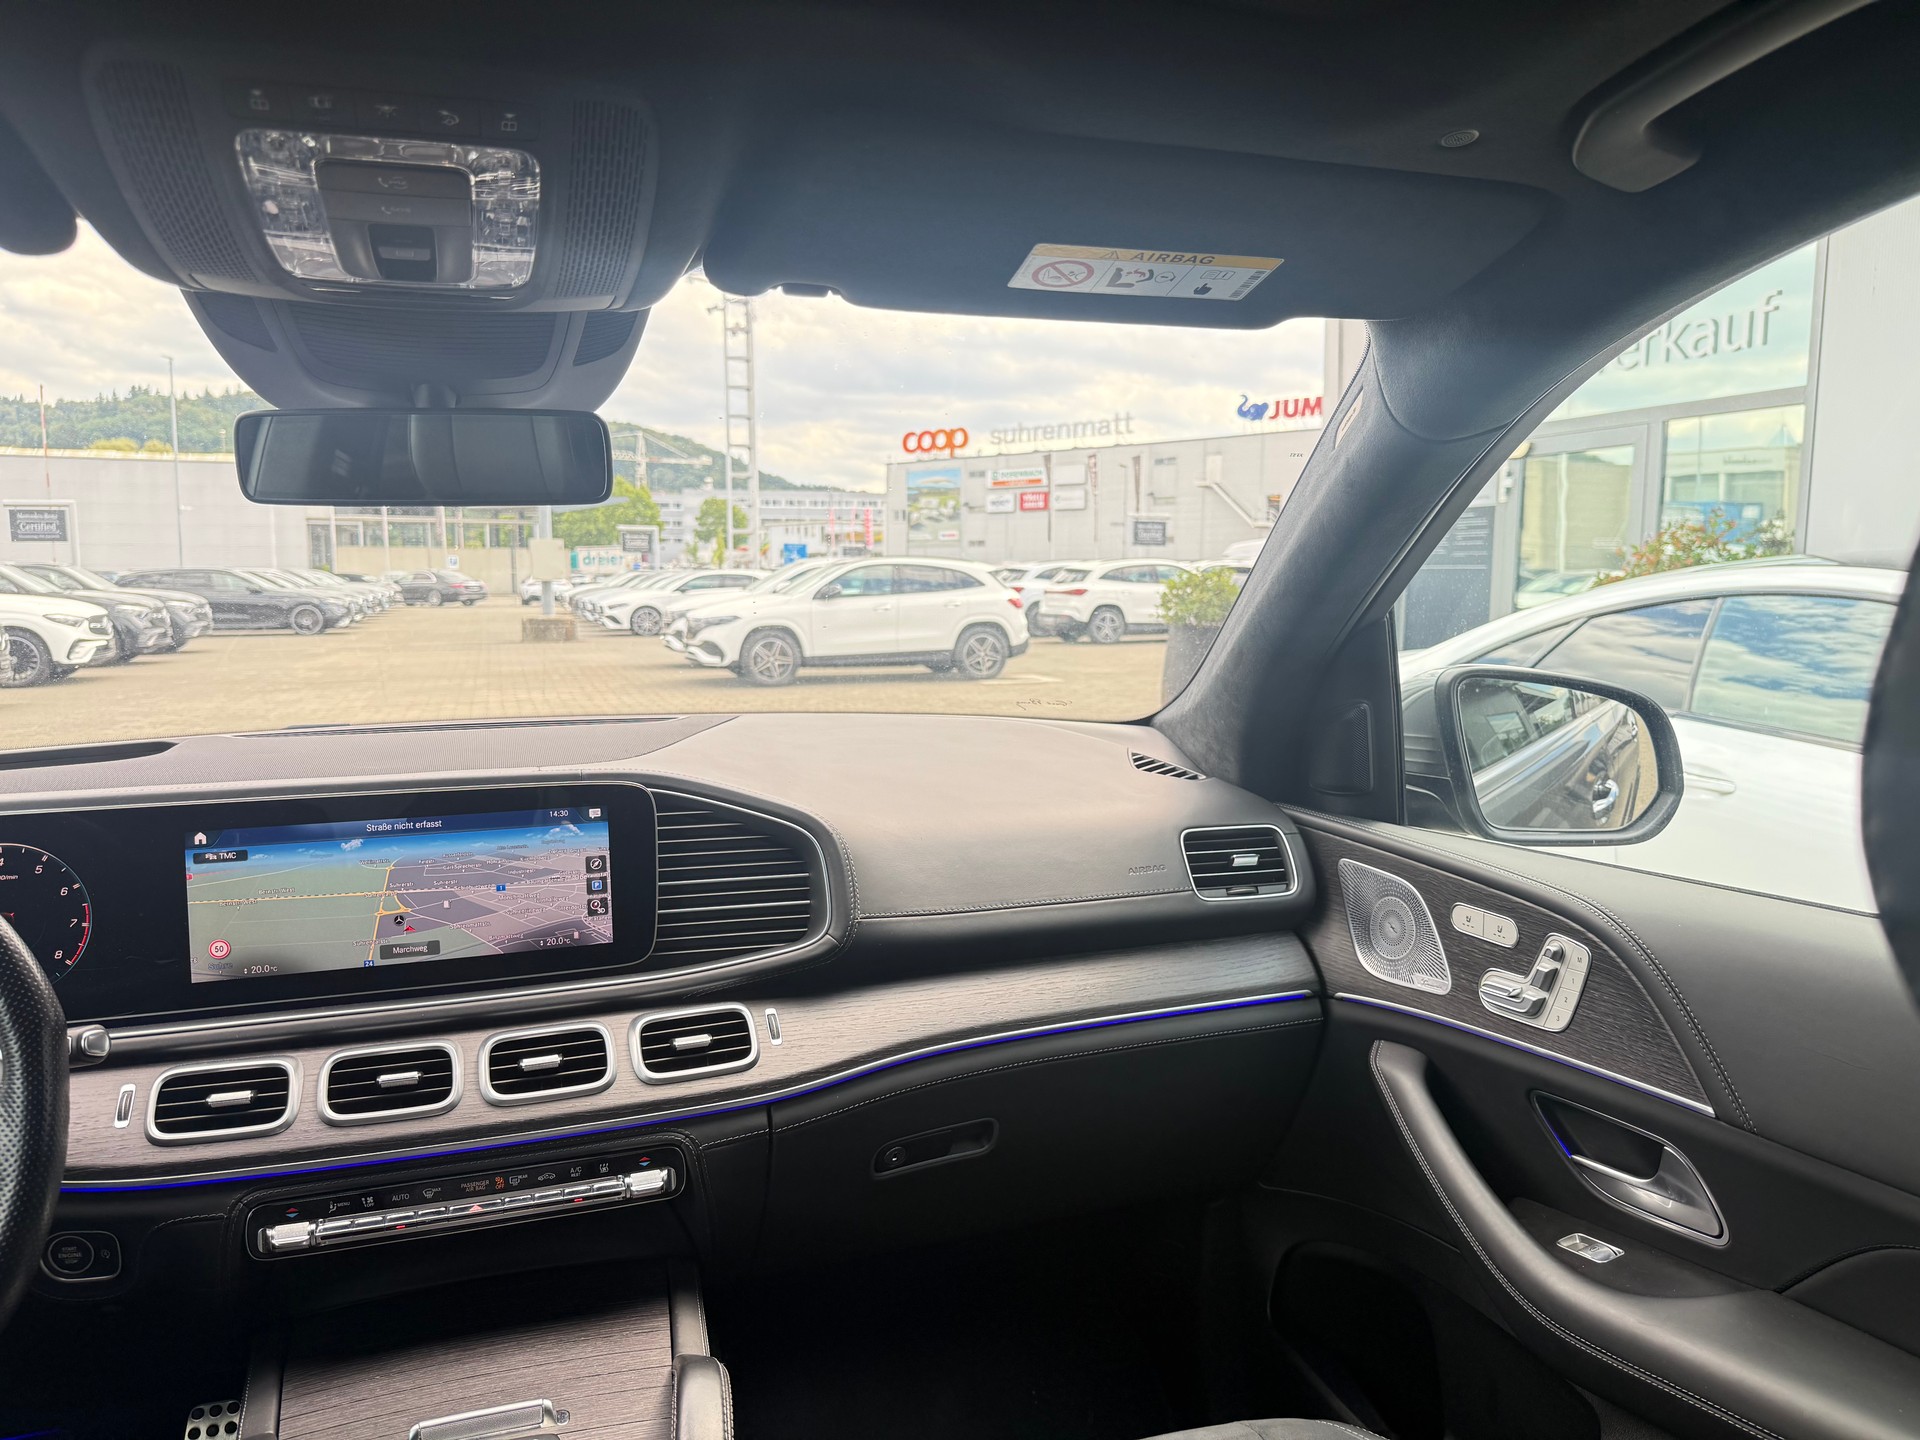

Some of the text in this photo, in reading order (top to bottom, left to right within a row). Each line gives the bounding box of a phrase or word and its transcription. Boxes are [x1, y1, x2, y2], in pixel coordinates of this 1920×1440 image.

[1130, 252, 1215, 265] AIRBAG
[1599, 289, 1783, 374] erkauf
[902, 412, 1135, 458] coop suhrenmatt
[549, 809, 569, 818] 14:30
[366, 819, 442, 832] Straße nicht erfasst
[218, 852, 237, 860] TMC
[34, 865, 43, 874] 5
[1128, 864, 1168, 876] AIRBAG
[60, 886, 69, 896] 6
[69, 918, 78, 928] 7
[214, 945, 224, 953] 50
[392, 945, 428, 955] Marchweg
[54, 950, 63, 959] 8
[570, 1166, 582, 1174] A/C
[460, 1179, 490, 1189] PASSENGER
[391, 1193, 410, 1202] AUTO
